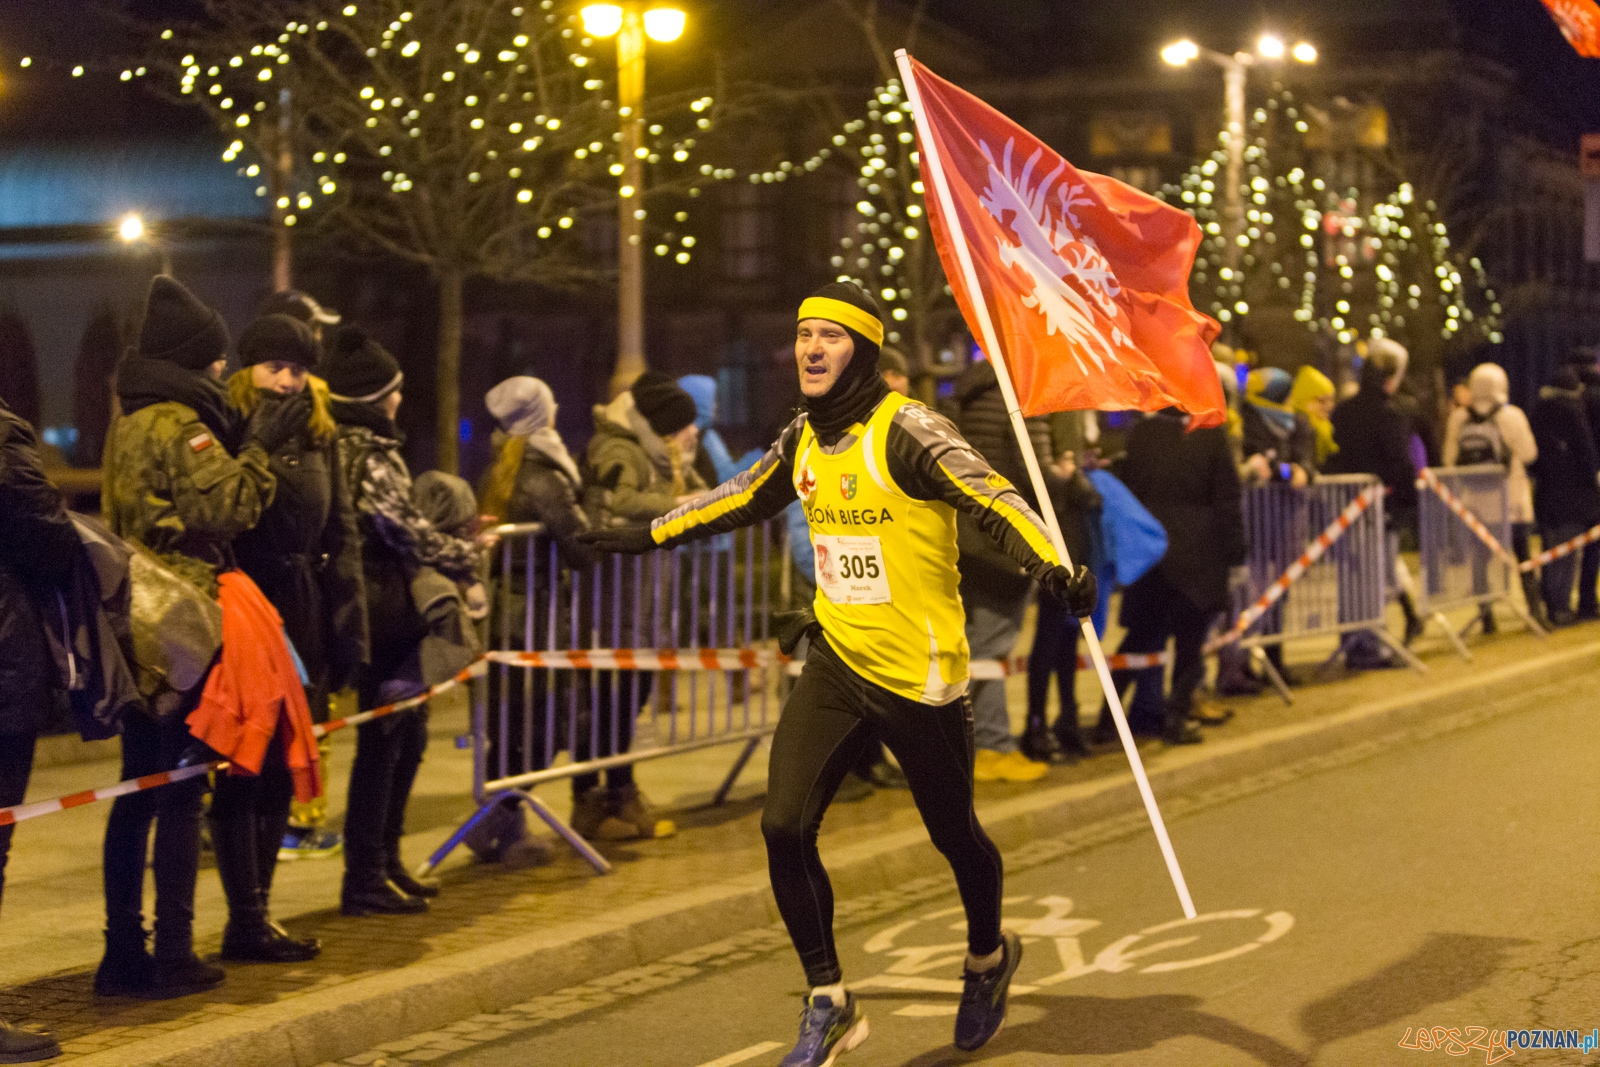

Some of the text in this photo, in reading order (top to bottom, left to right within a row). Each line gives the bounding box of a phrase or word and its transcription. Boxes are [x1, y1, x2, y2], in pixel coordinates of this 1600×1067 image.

[806, 504, 894, 525] BOŃ BIEGA
[839, 554, 880, 579] 305
